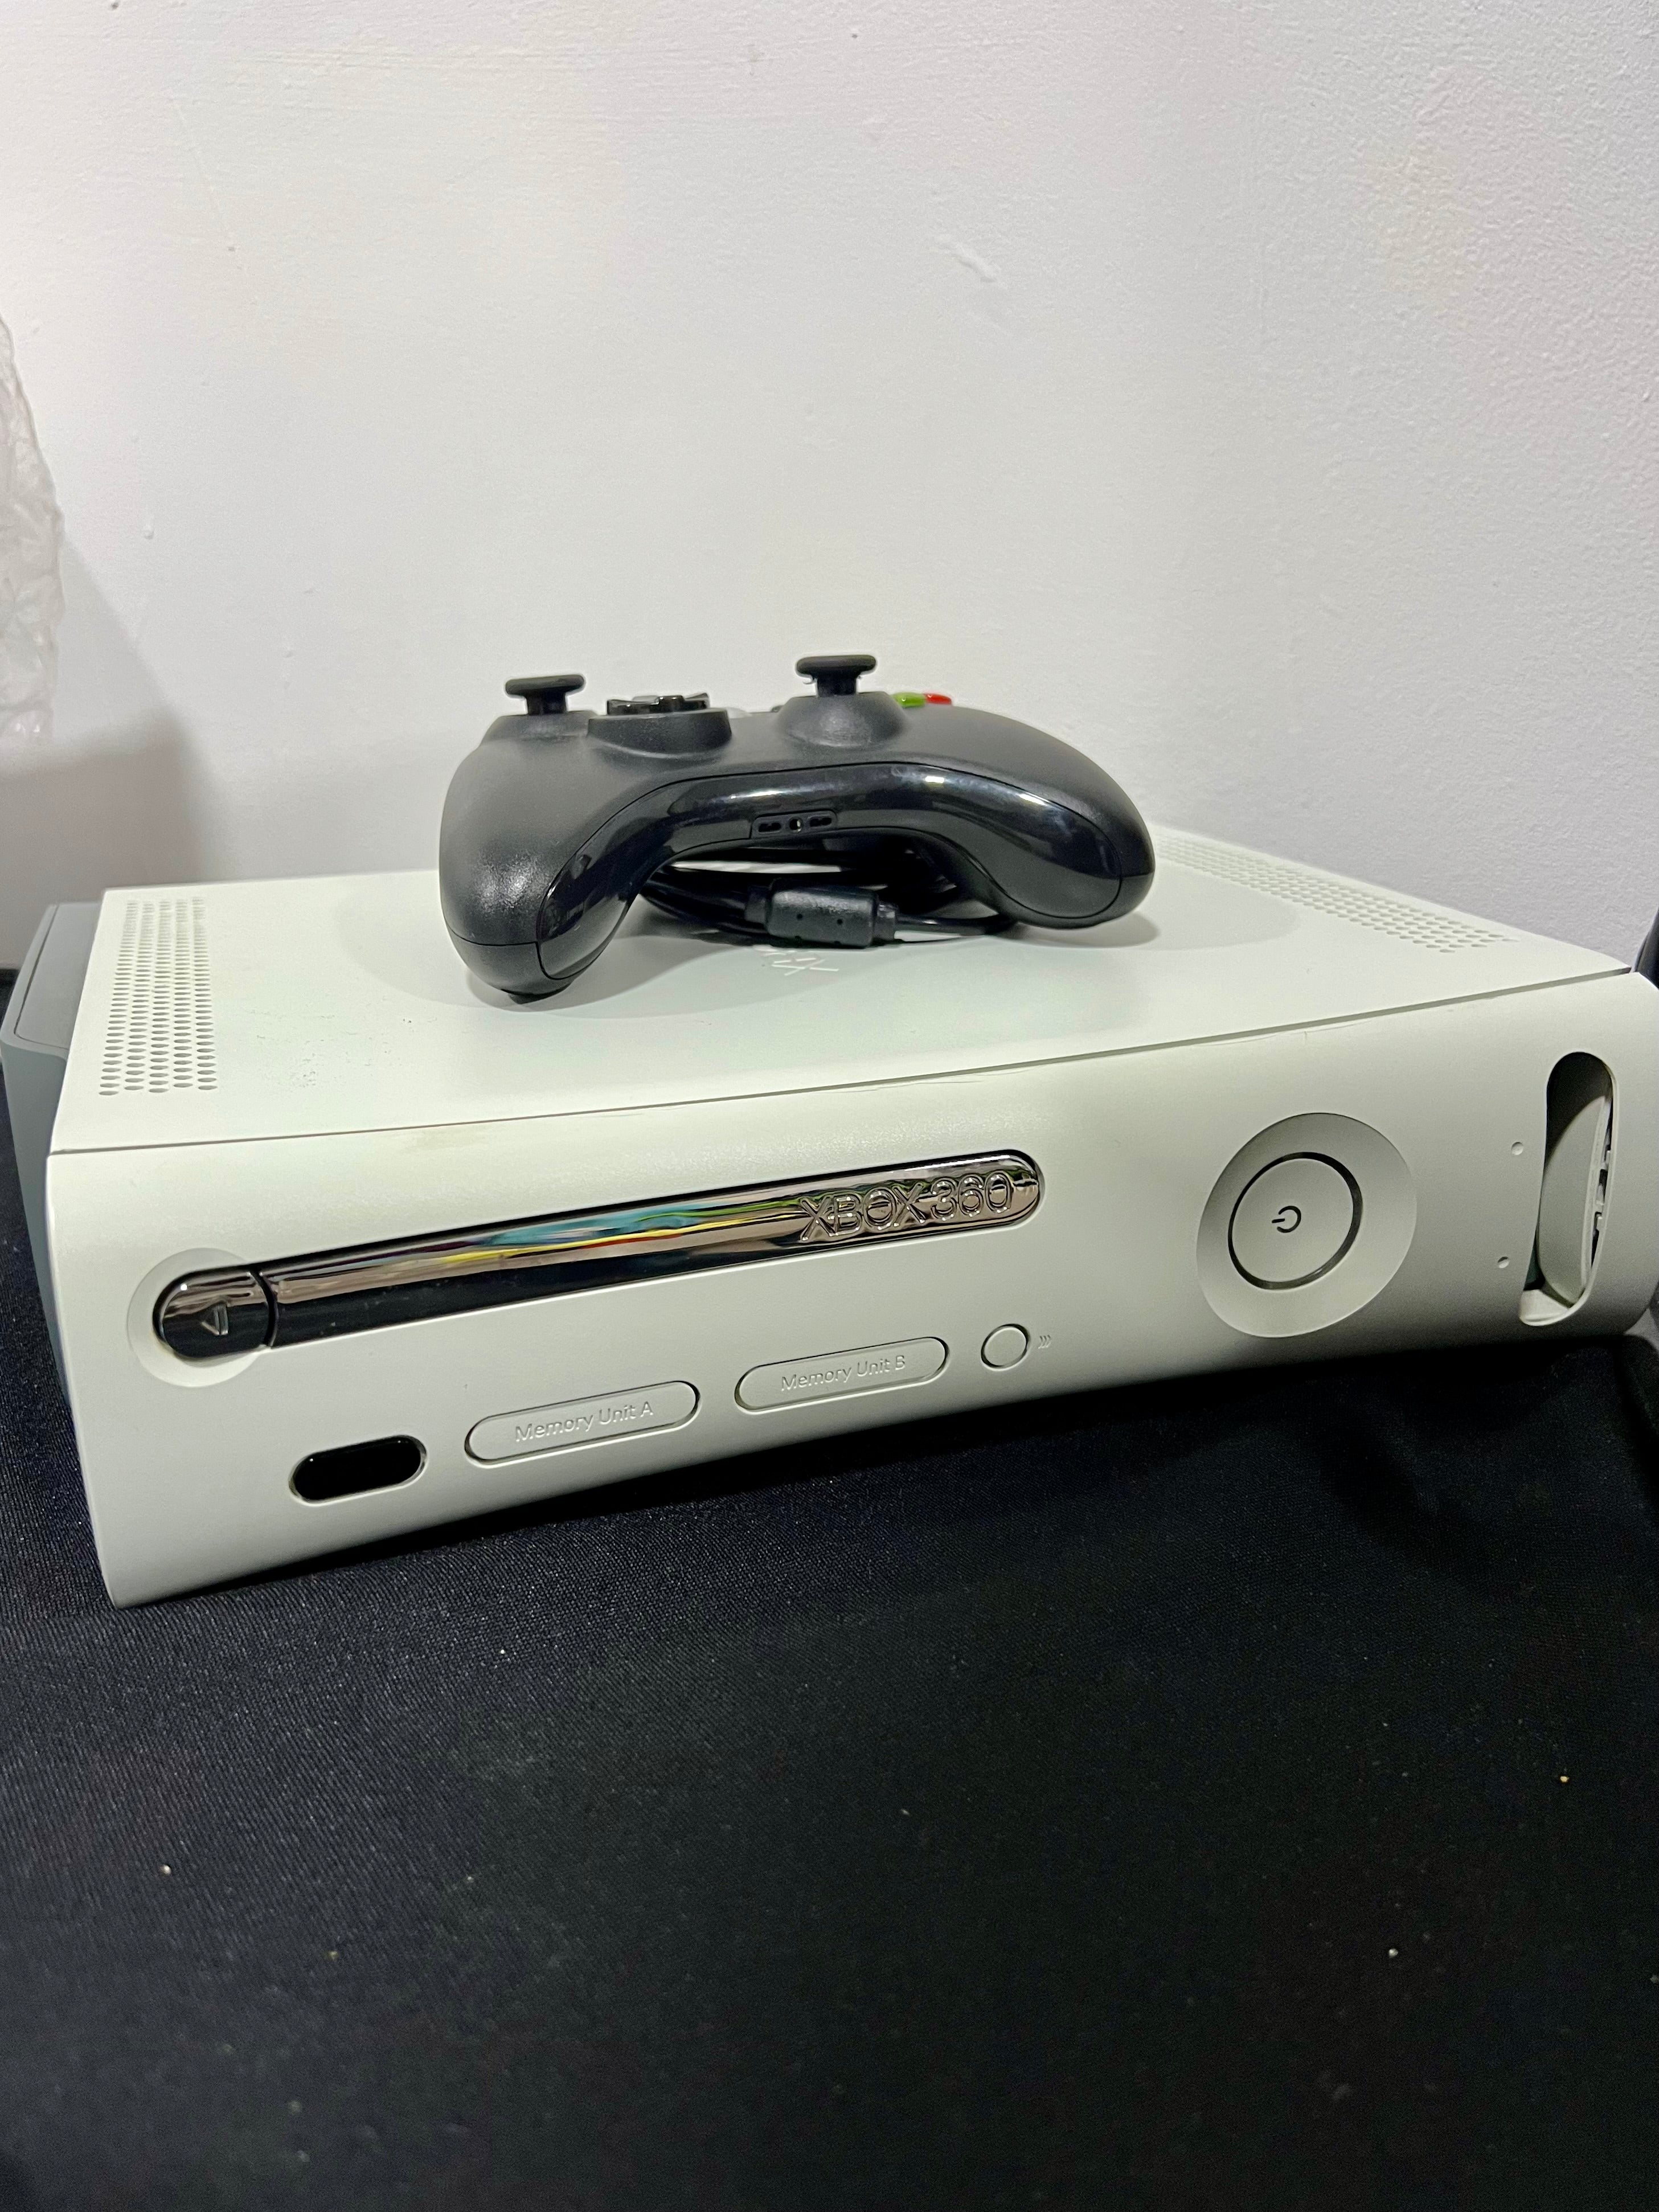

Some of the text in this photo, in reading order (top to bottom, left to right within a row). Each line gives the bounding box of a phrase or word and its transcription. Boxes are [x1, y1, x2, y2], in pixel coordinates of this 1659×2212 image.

[800, 1171, 1014, 1242] XBOX 360
[781, 1355, 906, 1391] Memory Unit B
[515, 1401, 654, 1442] Memory Unit A
